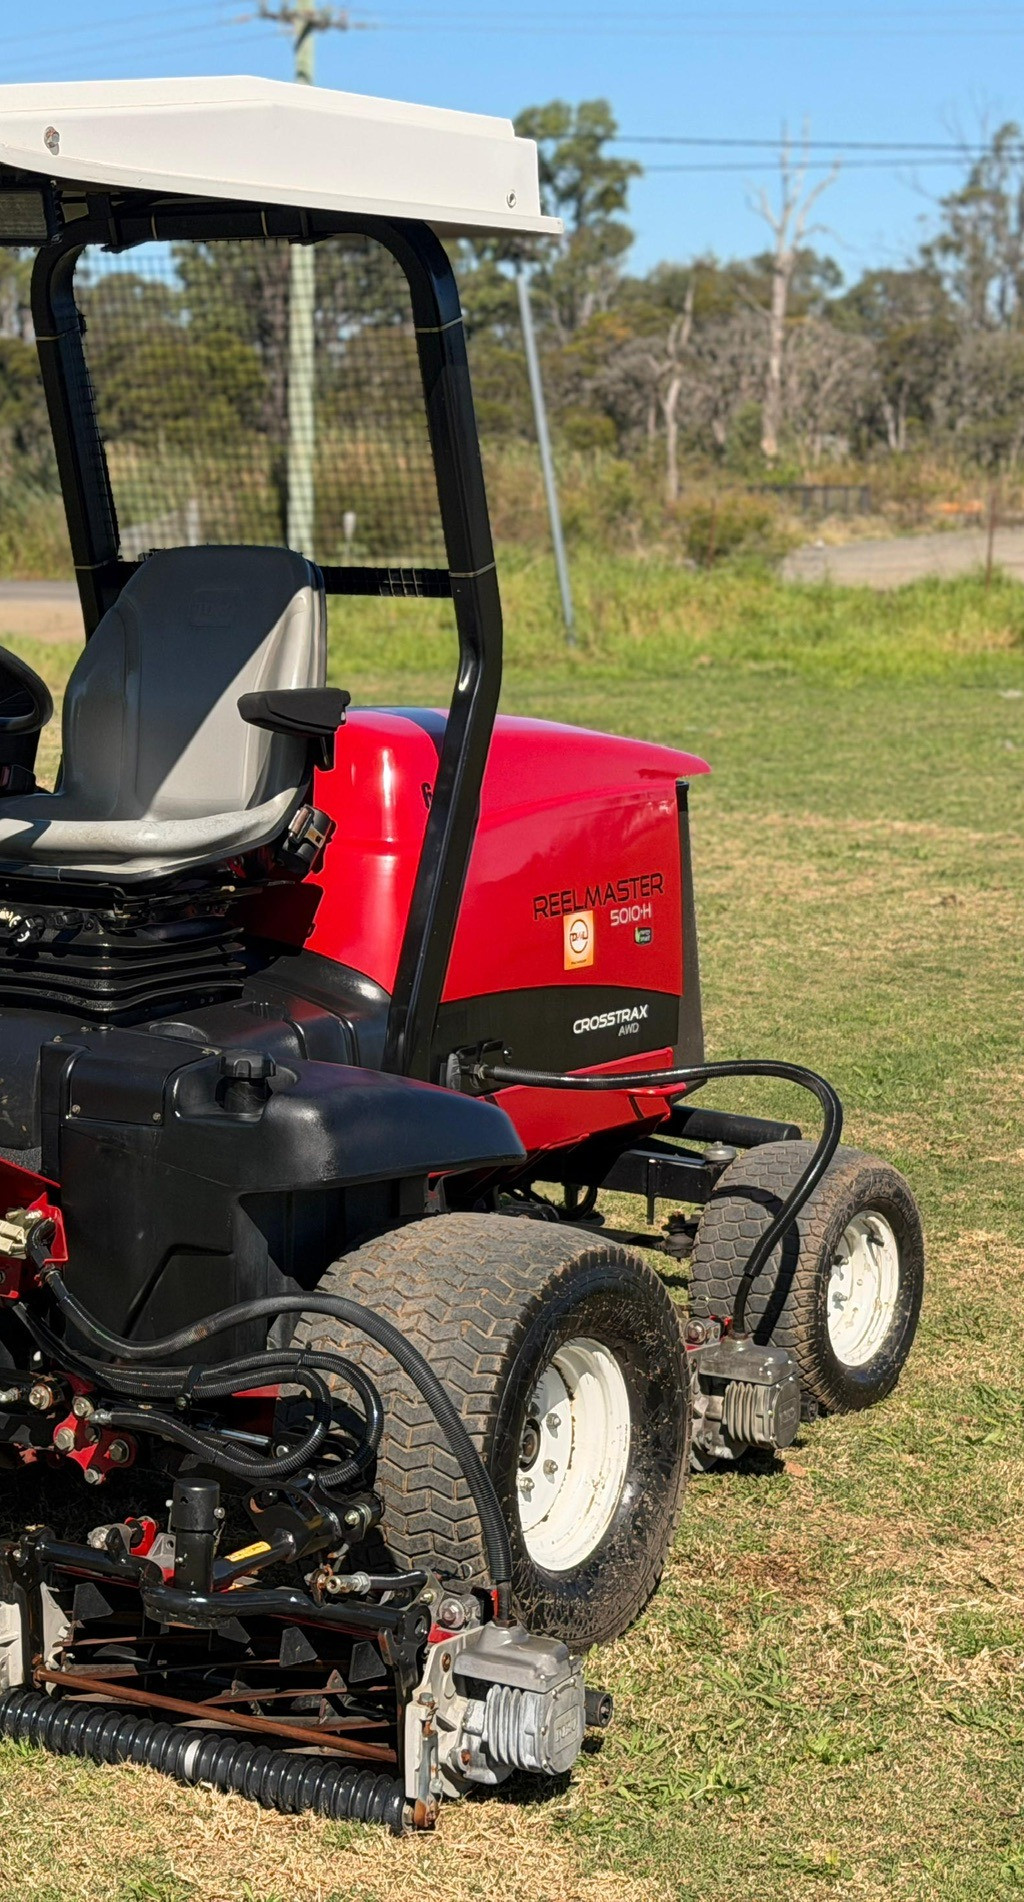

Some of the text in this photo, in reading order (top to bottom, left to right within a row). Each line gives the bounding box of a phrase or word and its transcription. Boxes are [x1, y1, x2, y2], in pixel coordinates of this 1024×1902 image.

[533, 872, 664, 920] REELMASTER
[573, 1003, 649, 1034] CROSSTRAX
[617, 1022, 640, 1037] AWD
